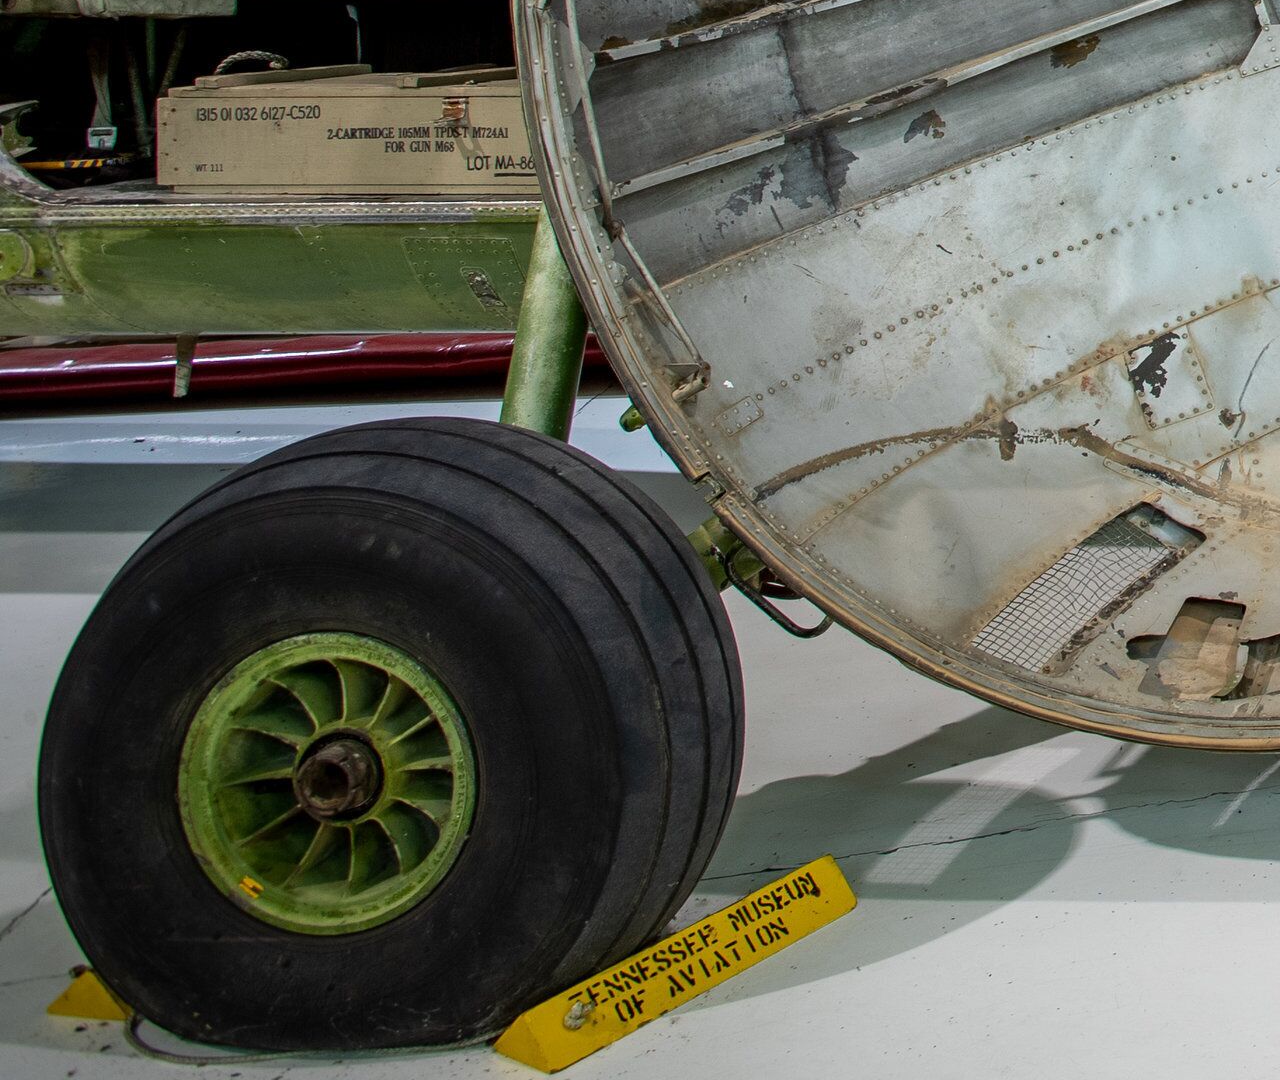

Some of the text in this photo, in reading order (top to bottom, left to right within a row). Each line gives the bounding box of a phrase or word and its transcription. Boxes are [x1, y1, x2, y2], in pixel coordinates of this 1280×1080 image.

[197, 107, 218, 121] 1315
[235, 107, 257, 121] 032
[261, 105, 321, 120] 6127-C520
[327, 128, 394, 139] 2-CARTRIDGE
[398, 126, 431, 138] 105MM
[472, 126, 509, 139] M724A1
[384, 140, 455, 153] FOR GUN M68
[466, 155, 536, 171] LOT MA-86
[614, 917, 790, 1023] OF AVIATION
